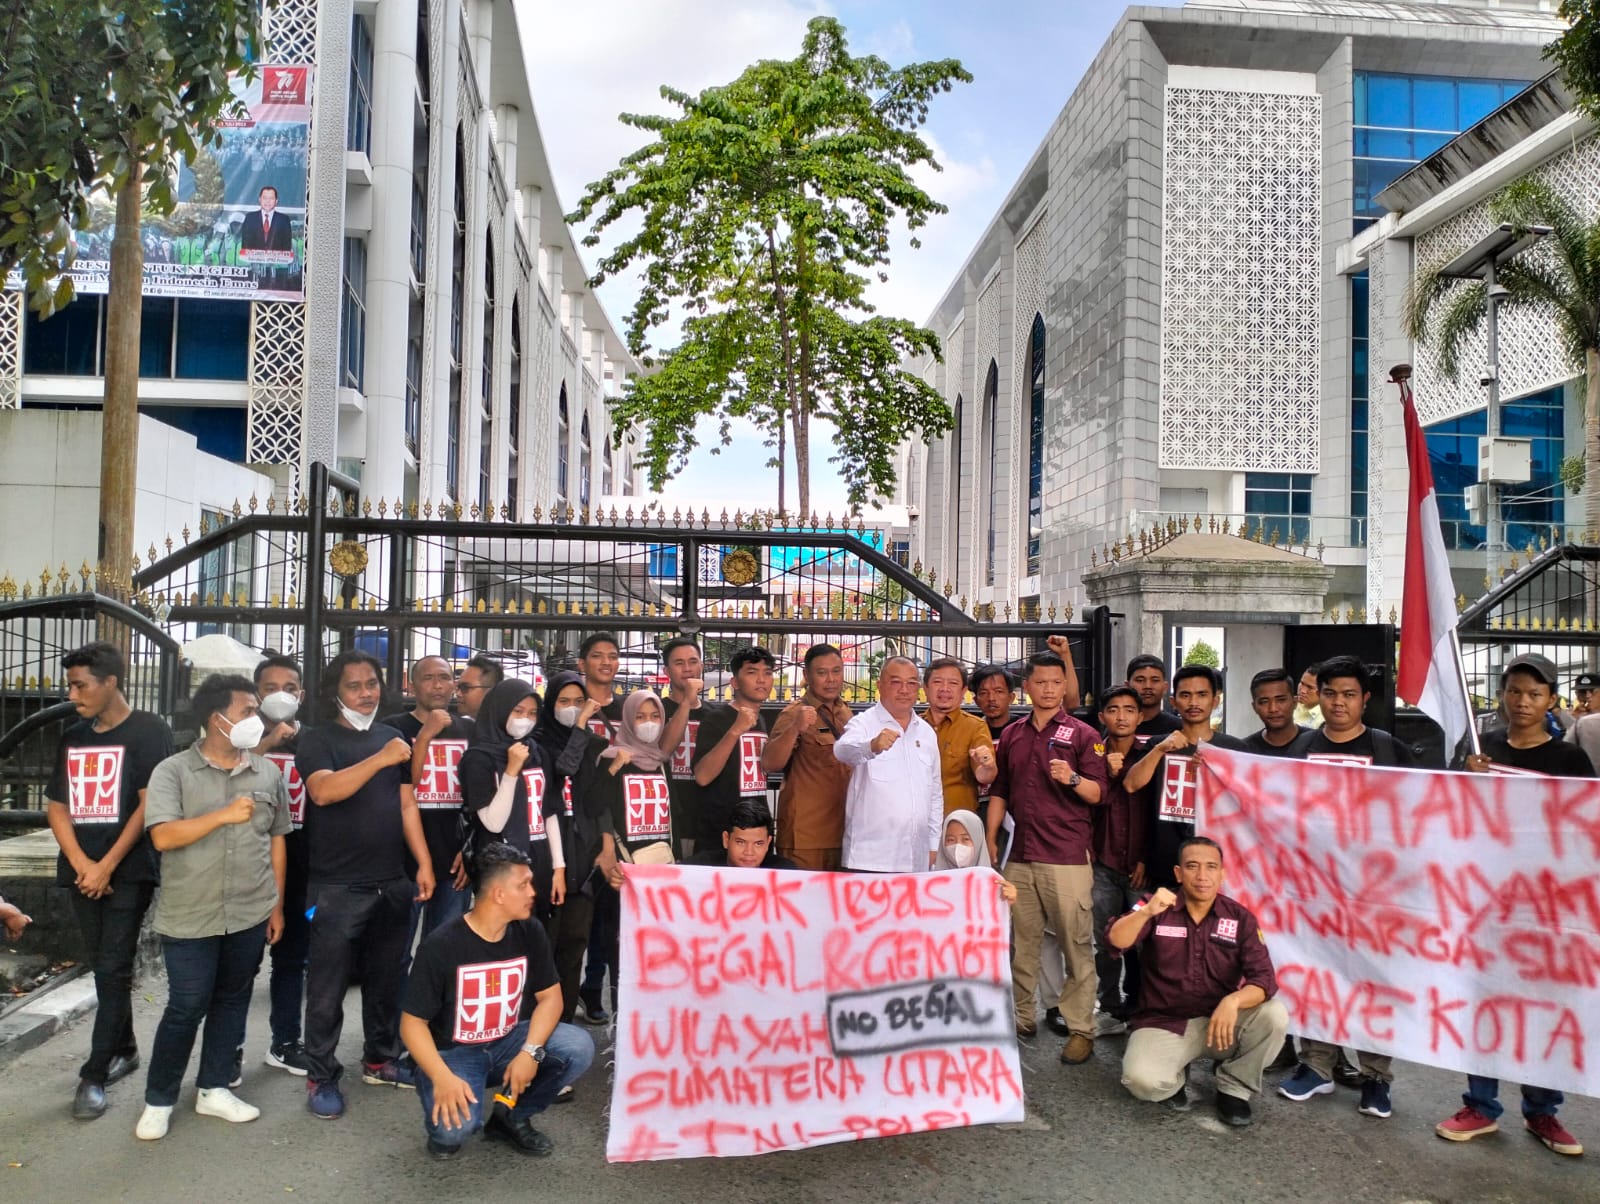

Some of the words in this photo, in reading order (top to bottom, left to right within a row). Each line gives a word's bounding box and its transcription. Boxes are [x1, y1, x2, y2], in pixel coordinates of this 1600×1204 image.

[142, 264, 182, 273] NTUK
[188, 265, 248, 276] NEGERI
[617, 863, 808, 934] Tindak
[811, 872, 955, 933] Tegas
[635, 926, 822, 998] BEGAL
[836, 1010, 878, 1039] NO
[884, 983, 995, 1031] BEGAL
[1276, 963, 1415, 1042] SAVE
[1427, 986, 1585, 1074] KOTA
[626, 1055, 866, 1114] SUMATERA
[883, 1046, 1021, 1102] UTARA
